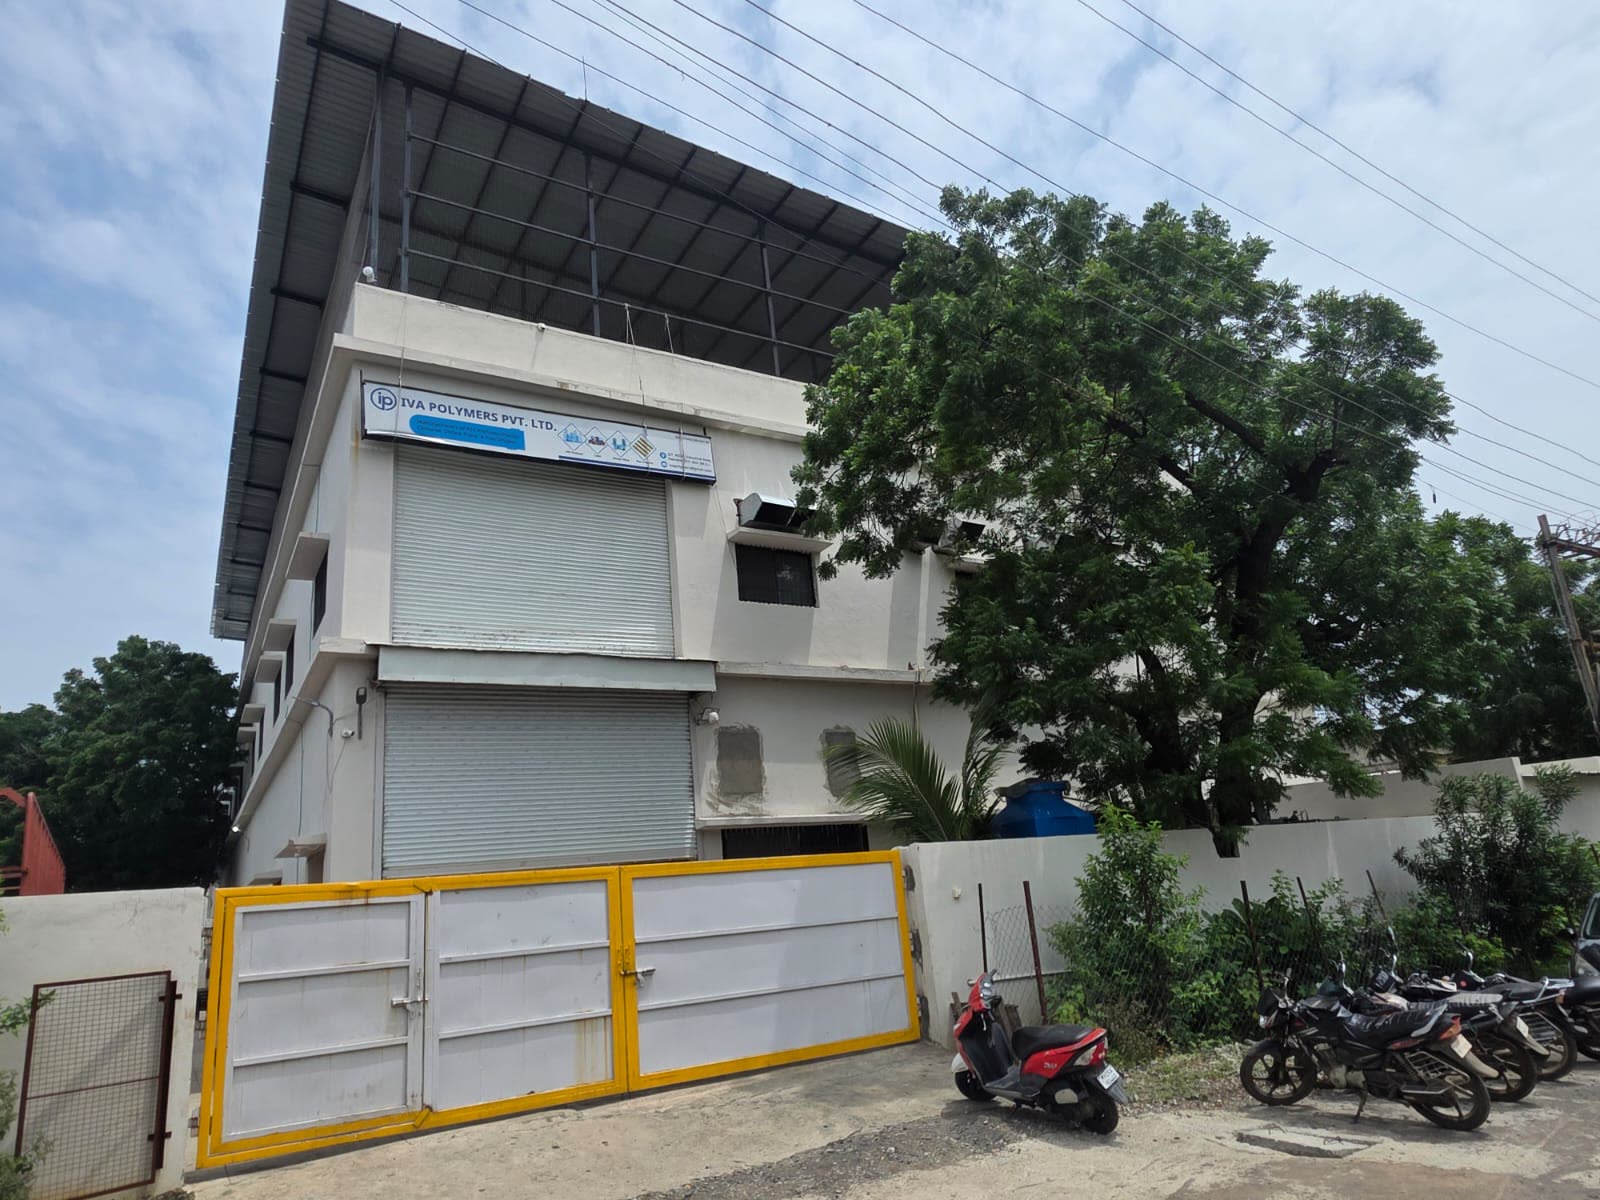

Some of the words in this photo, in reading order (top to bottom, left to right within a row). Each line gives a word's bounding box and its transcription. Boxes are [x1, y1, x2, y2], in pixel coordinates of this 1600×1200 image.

[401, 397, 426, 411] IVA
[429, 402, 499, 422] POLYMERS
[501, 414, 528, 427] PVT.
[531, 418, 557, 432] LTD.
